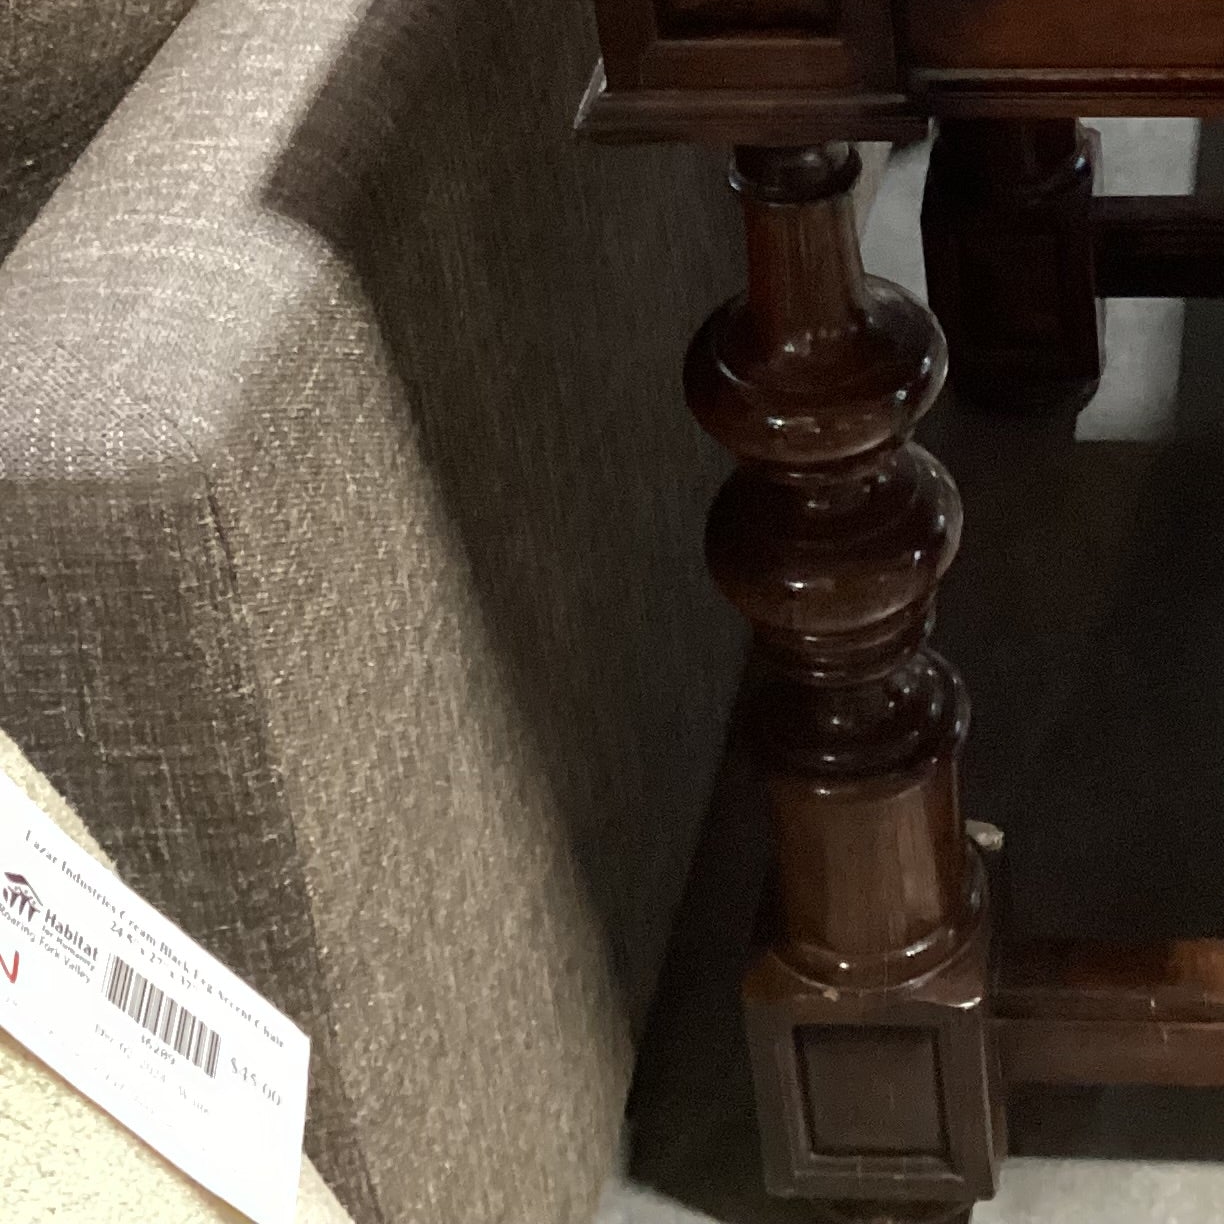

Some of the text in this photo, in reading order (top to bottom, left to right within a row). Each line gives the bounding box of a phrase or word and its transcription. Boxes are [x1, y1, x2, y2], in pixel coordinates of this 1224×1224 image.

[61, 860, 117, 914] Industries
[39, 936, 60, 960] Fork
[64, 955, 91, 984] Valley
[44, 908, 98, 962] Habitat
